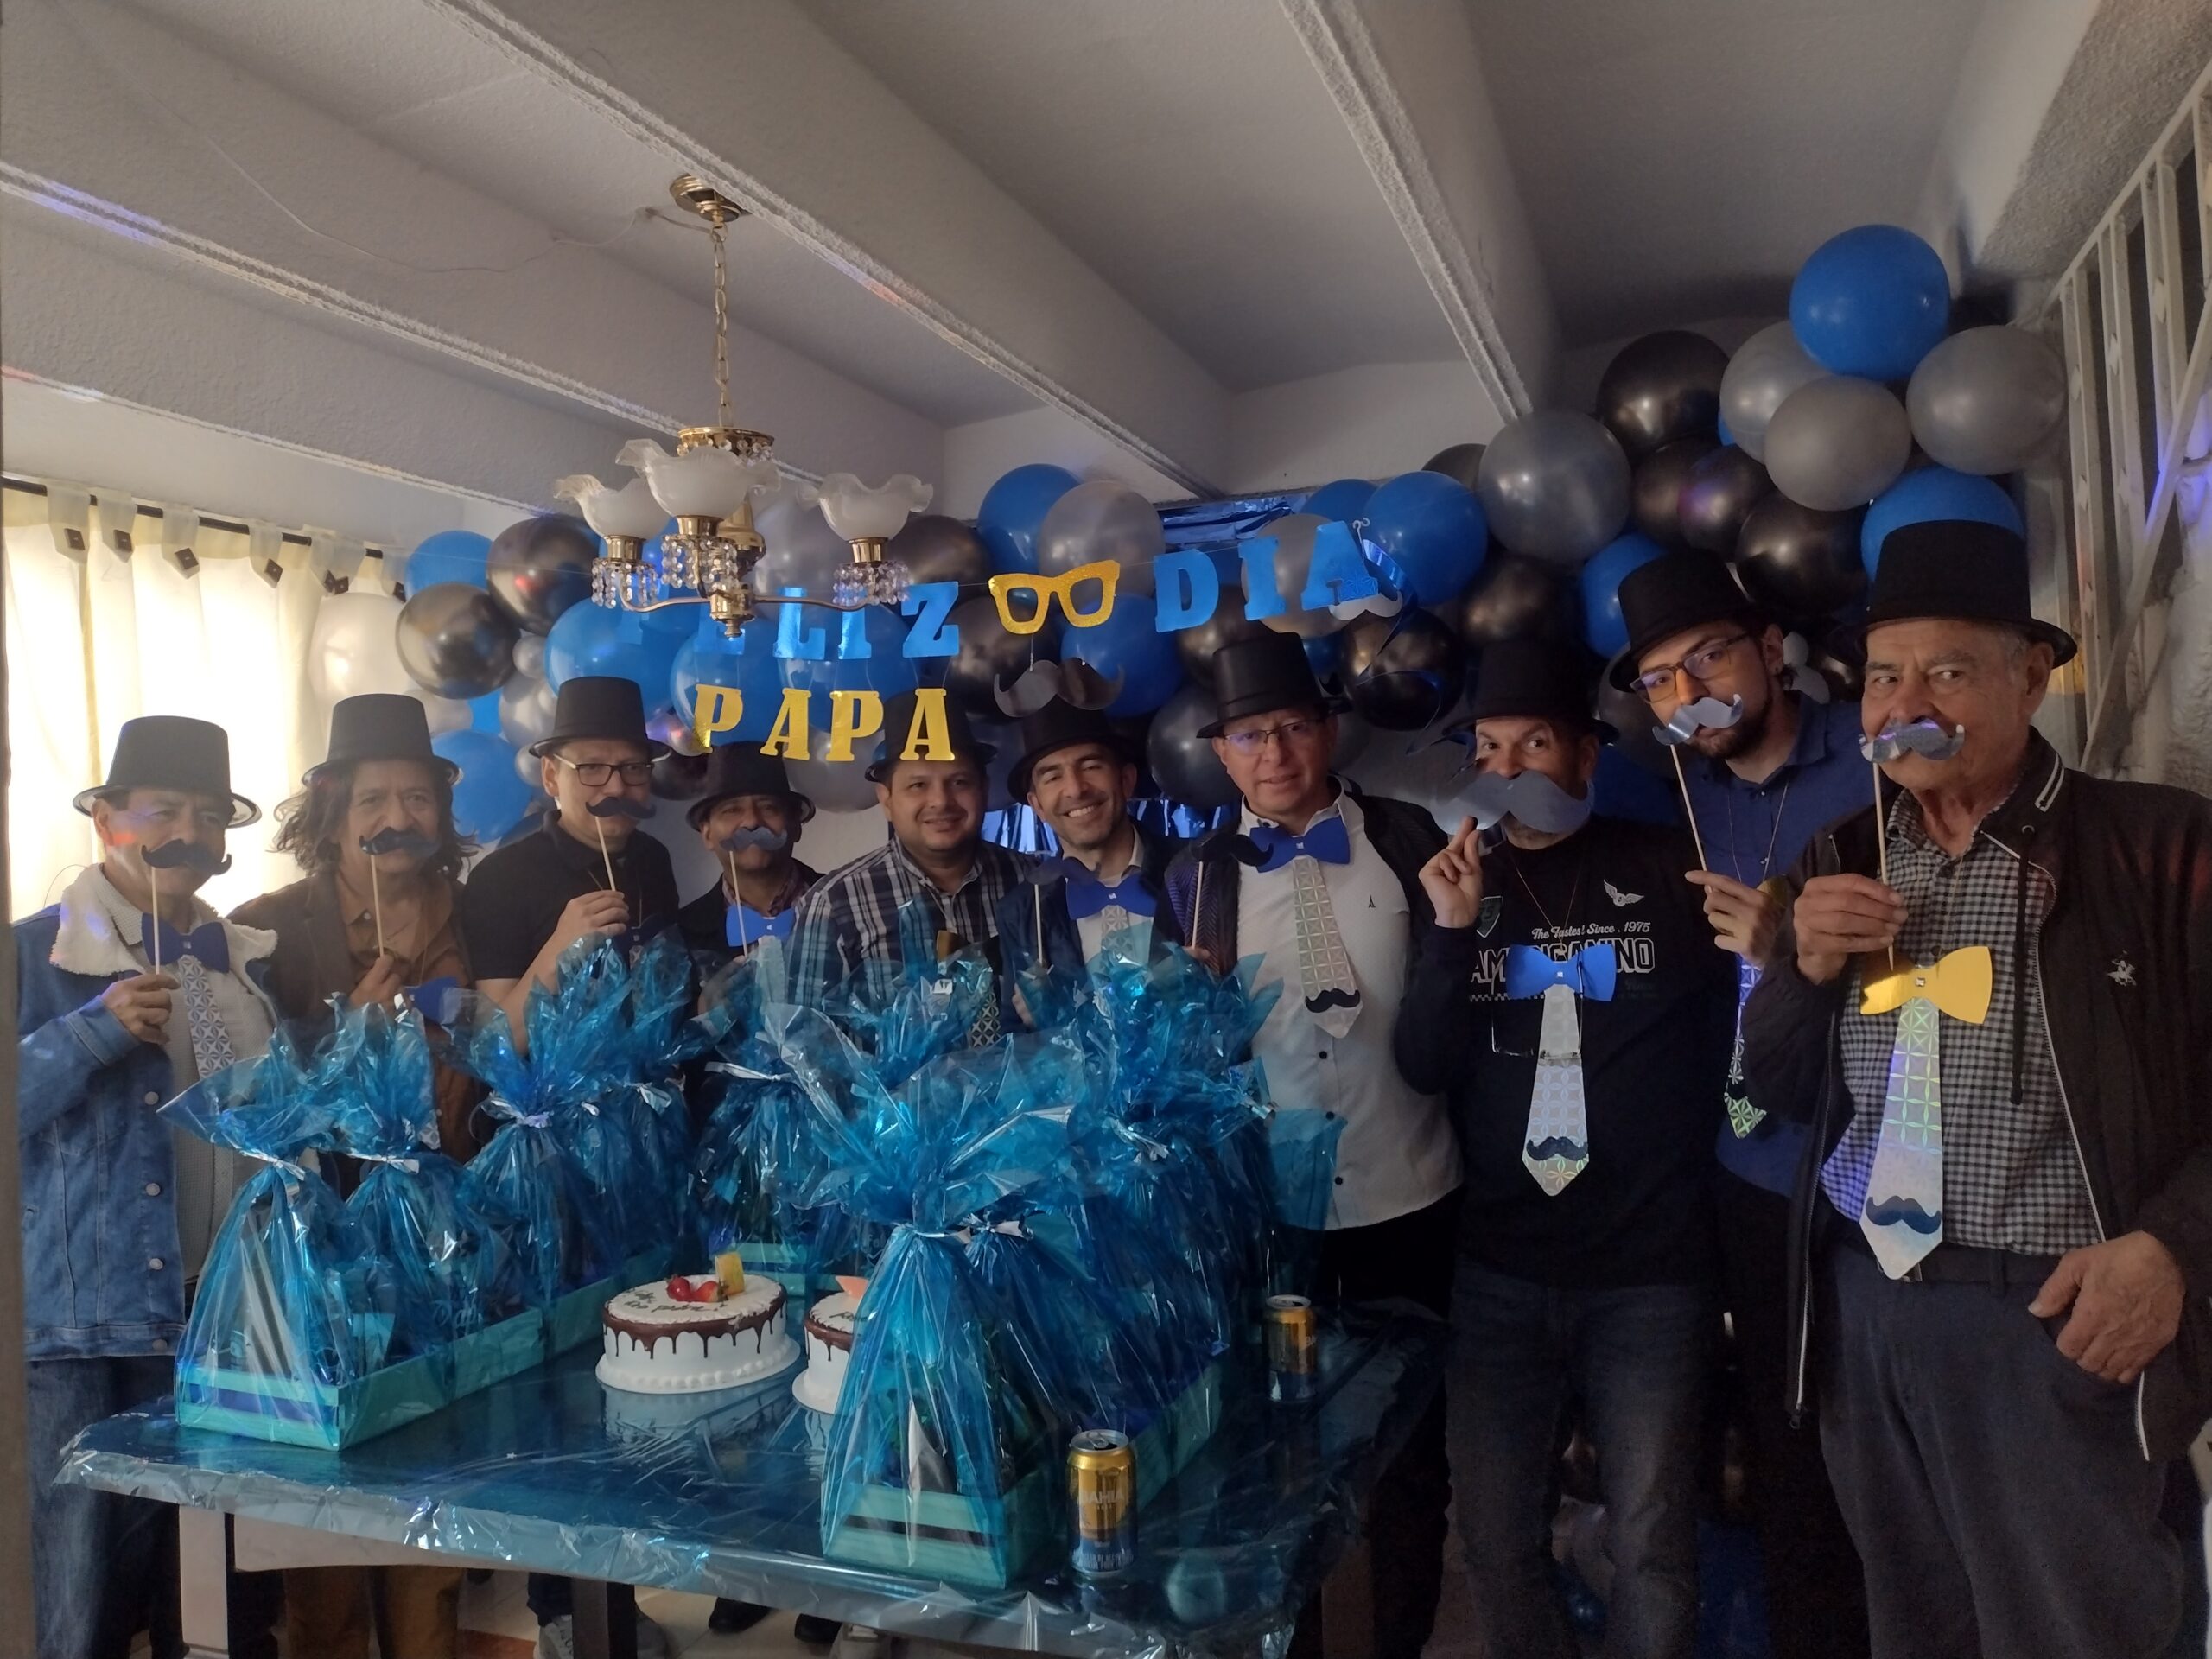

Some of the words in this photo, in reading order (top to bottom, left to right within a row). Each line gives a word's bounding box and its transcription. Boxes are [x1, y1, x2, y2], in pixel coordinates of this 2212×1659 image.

[694, 684, 956, 762] PAPA
[1531, 927, 1549, 940] The
[1586, 922, 1616, 935] Since
[1624, 921, 1651, 933] 1975
